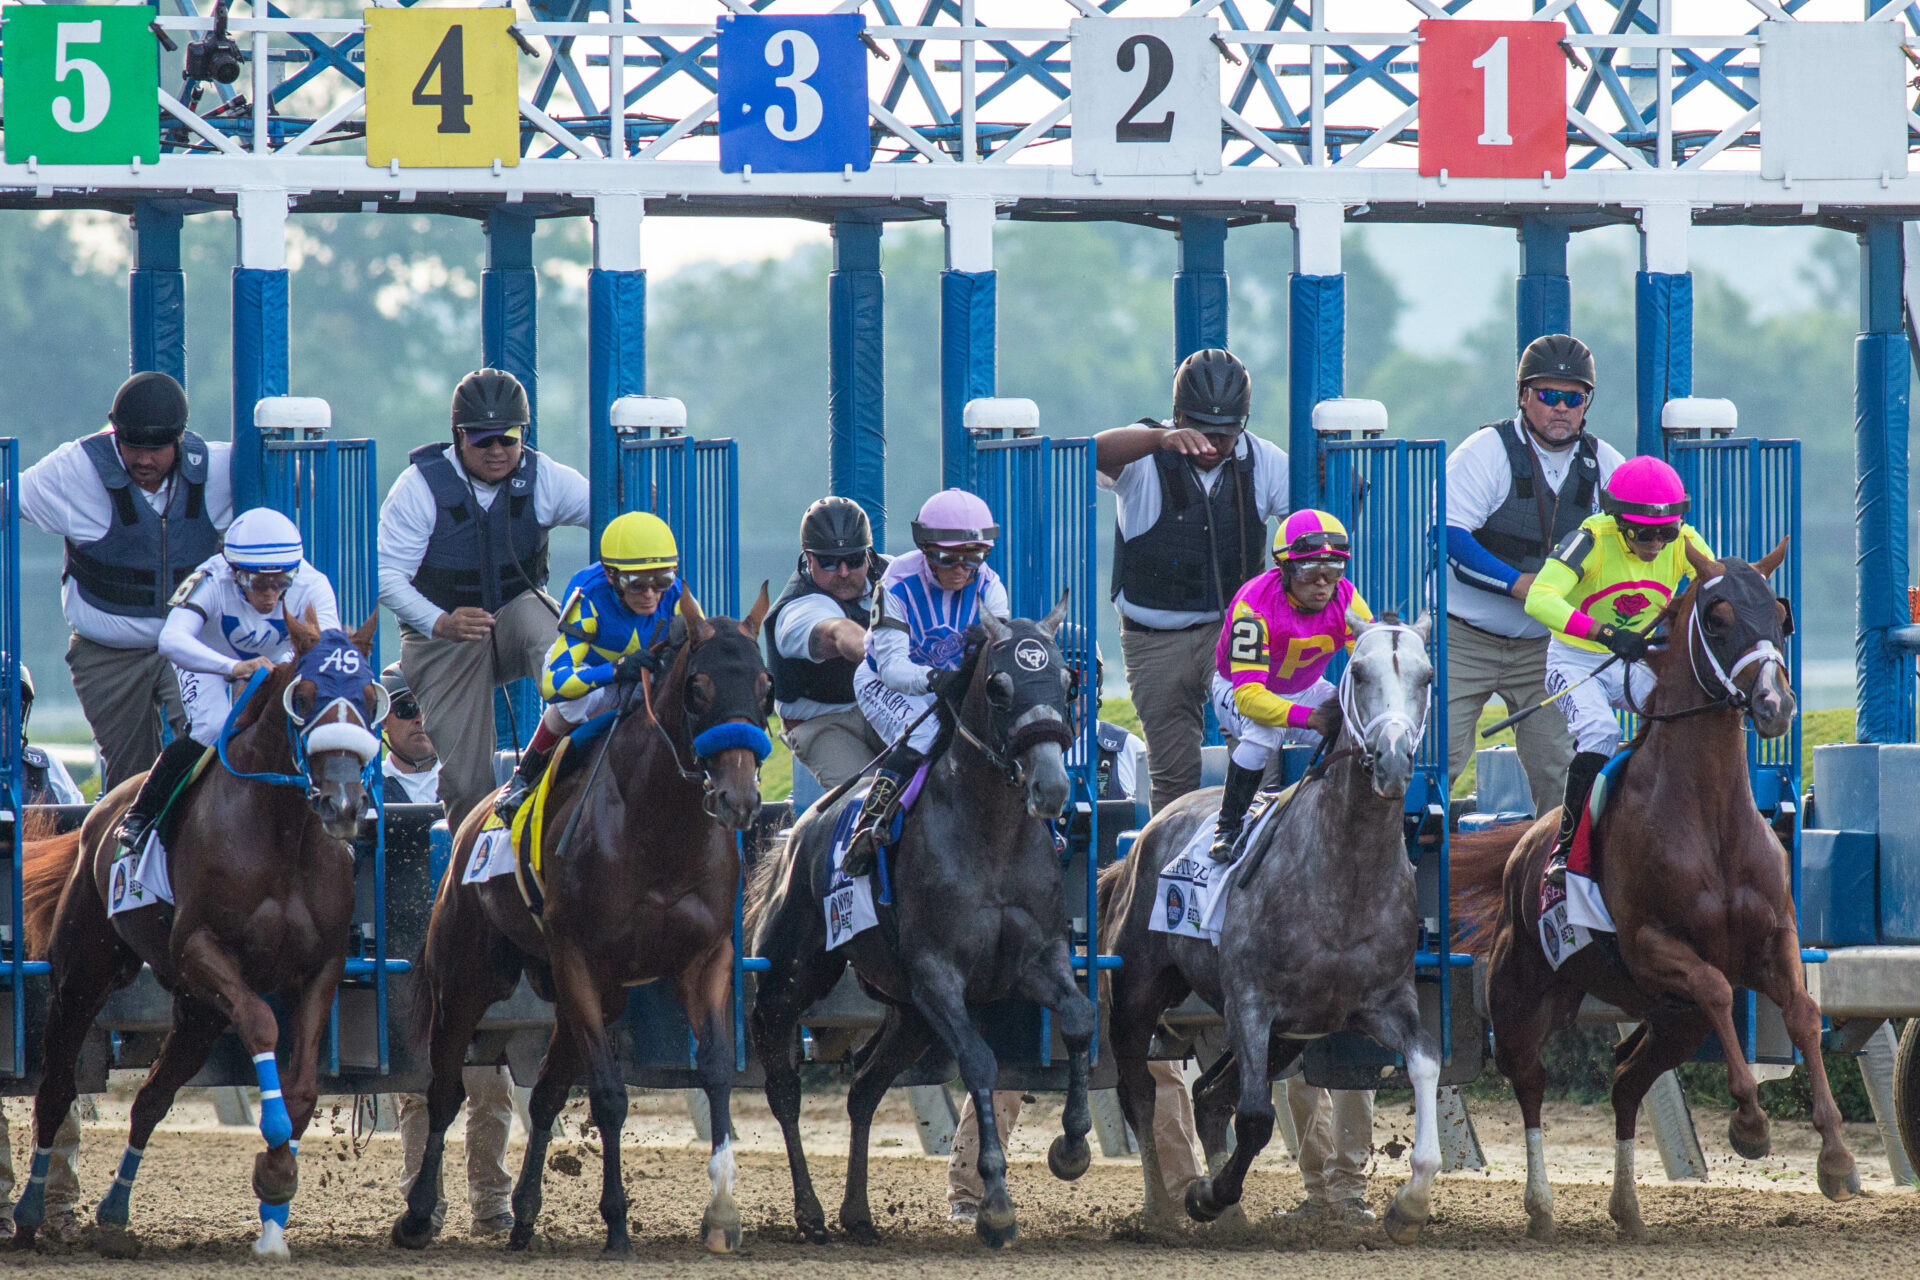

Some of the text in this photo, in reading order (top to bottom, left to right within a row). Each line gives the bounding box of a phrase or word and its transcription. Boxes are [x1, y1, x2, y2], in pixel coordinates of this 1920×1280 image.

[51, 19, 112, 133] 5
[411, 24, 474, 134] 4
[763, 29, 824, 142] 3
[1115, 34, 1176, 143] 2
[1471, 36, 1514, 146] 1
[318, 647, 360, 674] AS
[1231, 621, 1259, 661] 2
[1276, 634, 1336, 681] P
